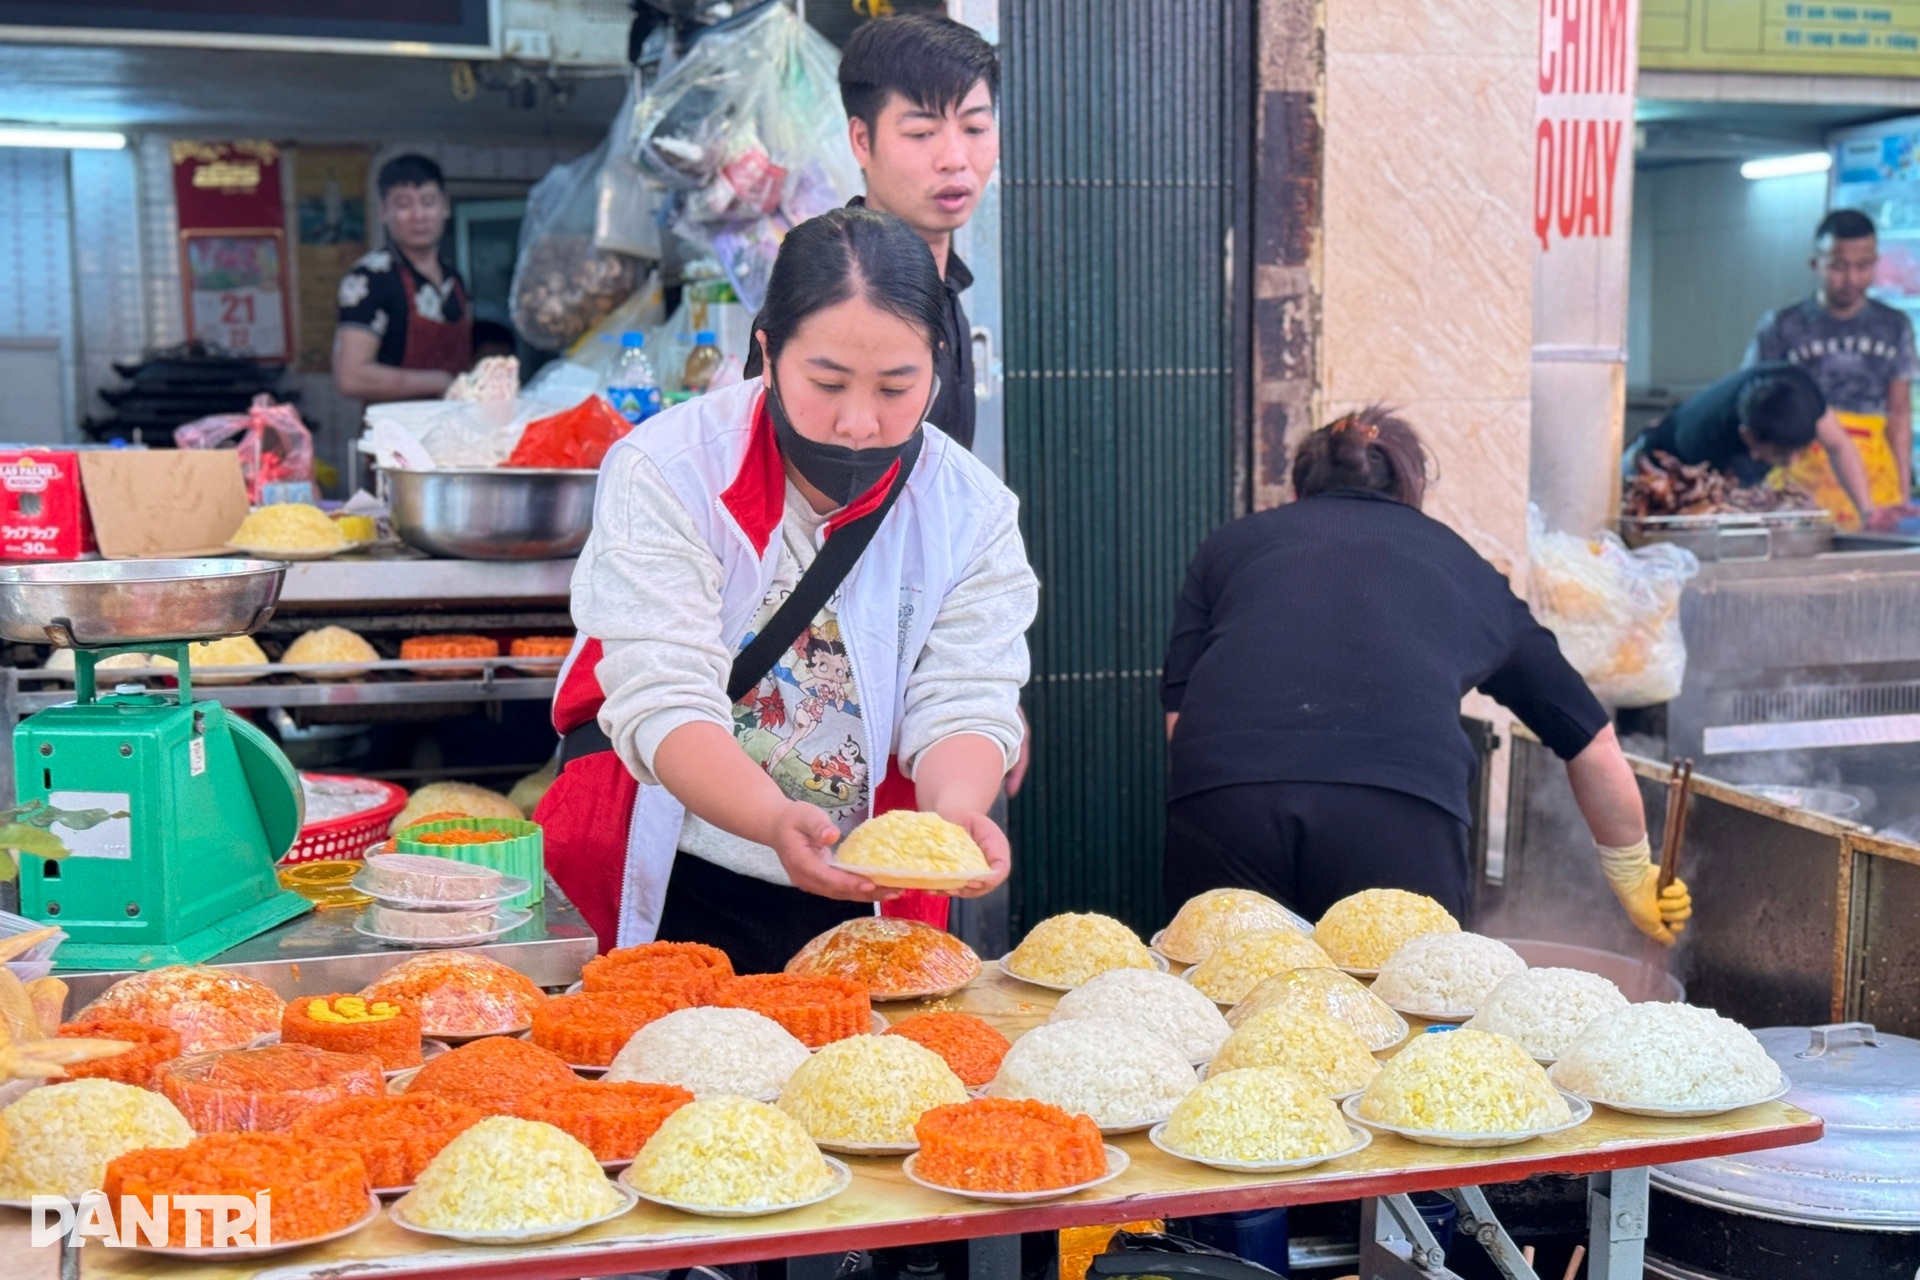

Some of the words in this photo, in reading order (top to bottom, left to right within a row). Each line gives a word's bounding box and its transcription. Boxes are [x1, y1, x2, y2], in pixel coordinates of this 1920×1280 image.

[1538, 0, 1627, 94] CHIM
[1534, 118, 1623, 251] QUAY
[220, 291, 256, 324] 21
[22, 541, 46, 555] 30
